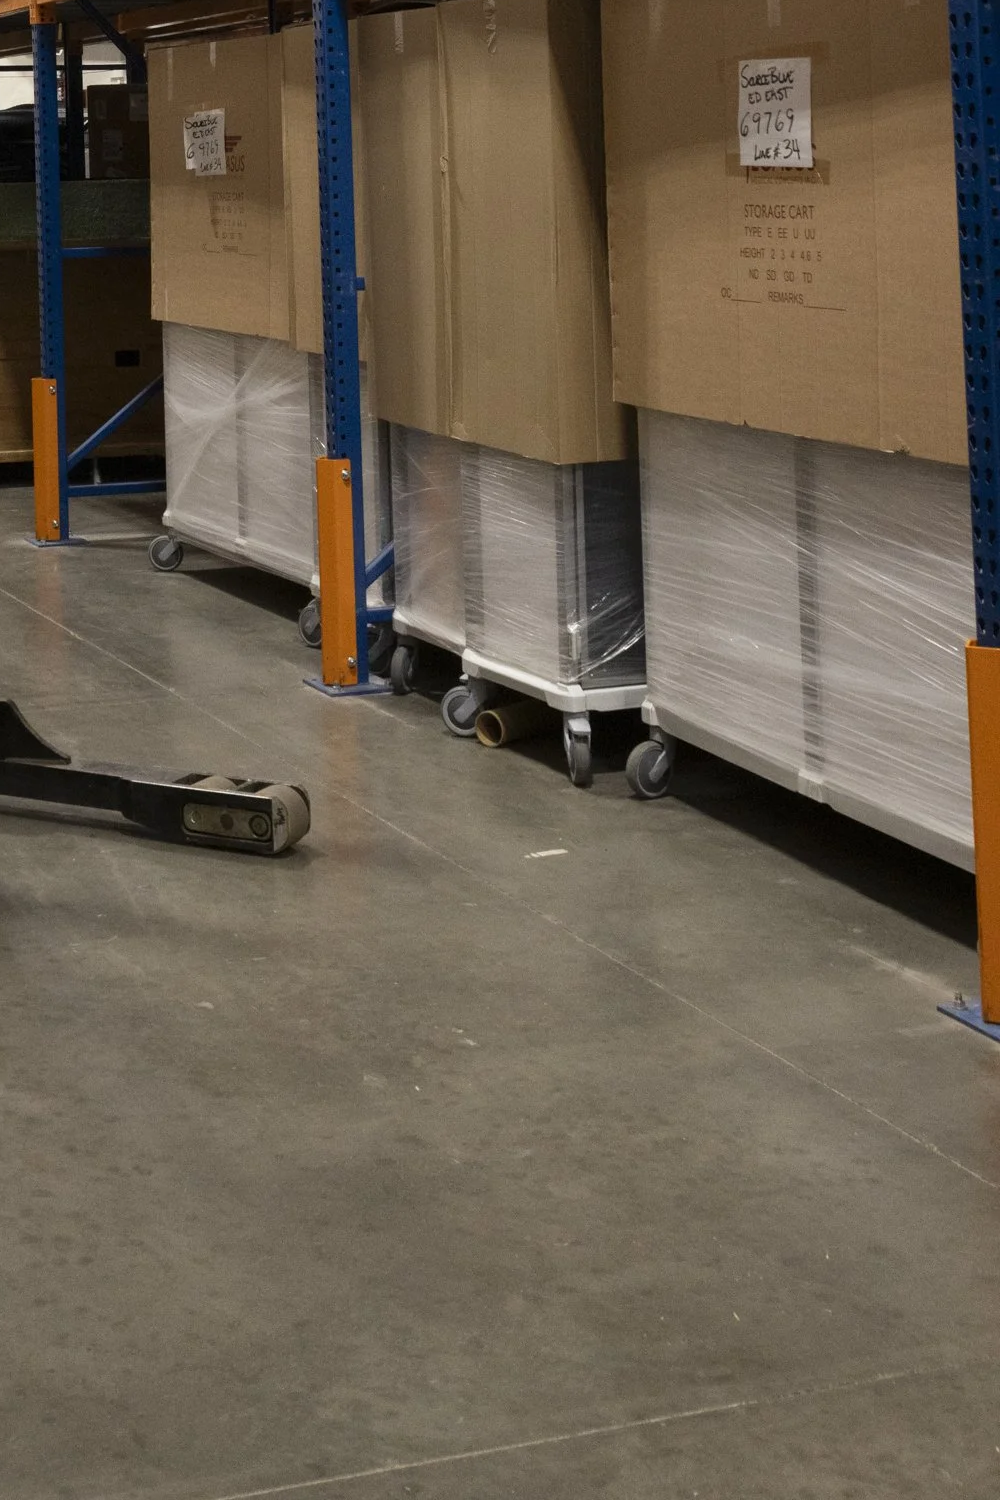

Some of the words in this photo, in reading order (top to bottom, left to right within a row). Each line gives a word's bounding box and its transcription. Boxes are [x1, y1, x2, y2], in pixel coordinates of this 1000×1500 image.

[740, 108, 794, 137] 69769
[744, 204, 787, 219] STORAGE
[788, 204, 815, 220] CART
[744, 226, 762, 238] TYPE
[767, 227, 773, 239] E
[777, 227, 788, 239] EE
[793, 228, 799, 240] U
[740, 247, 765, 259] HEIGHT
[770, 248, 776, 260] 2
[780, 249, 786, 260] 3
[790, 250, 796, 260] 4
[768, 291, 804, 305] REMARKS
